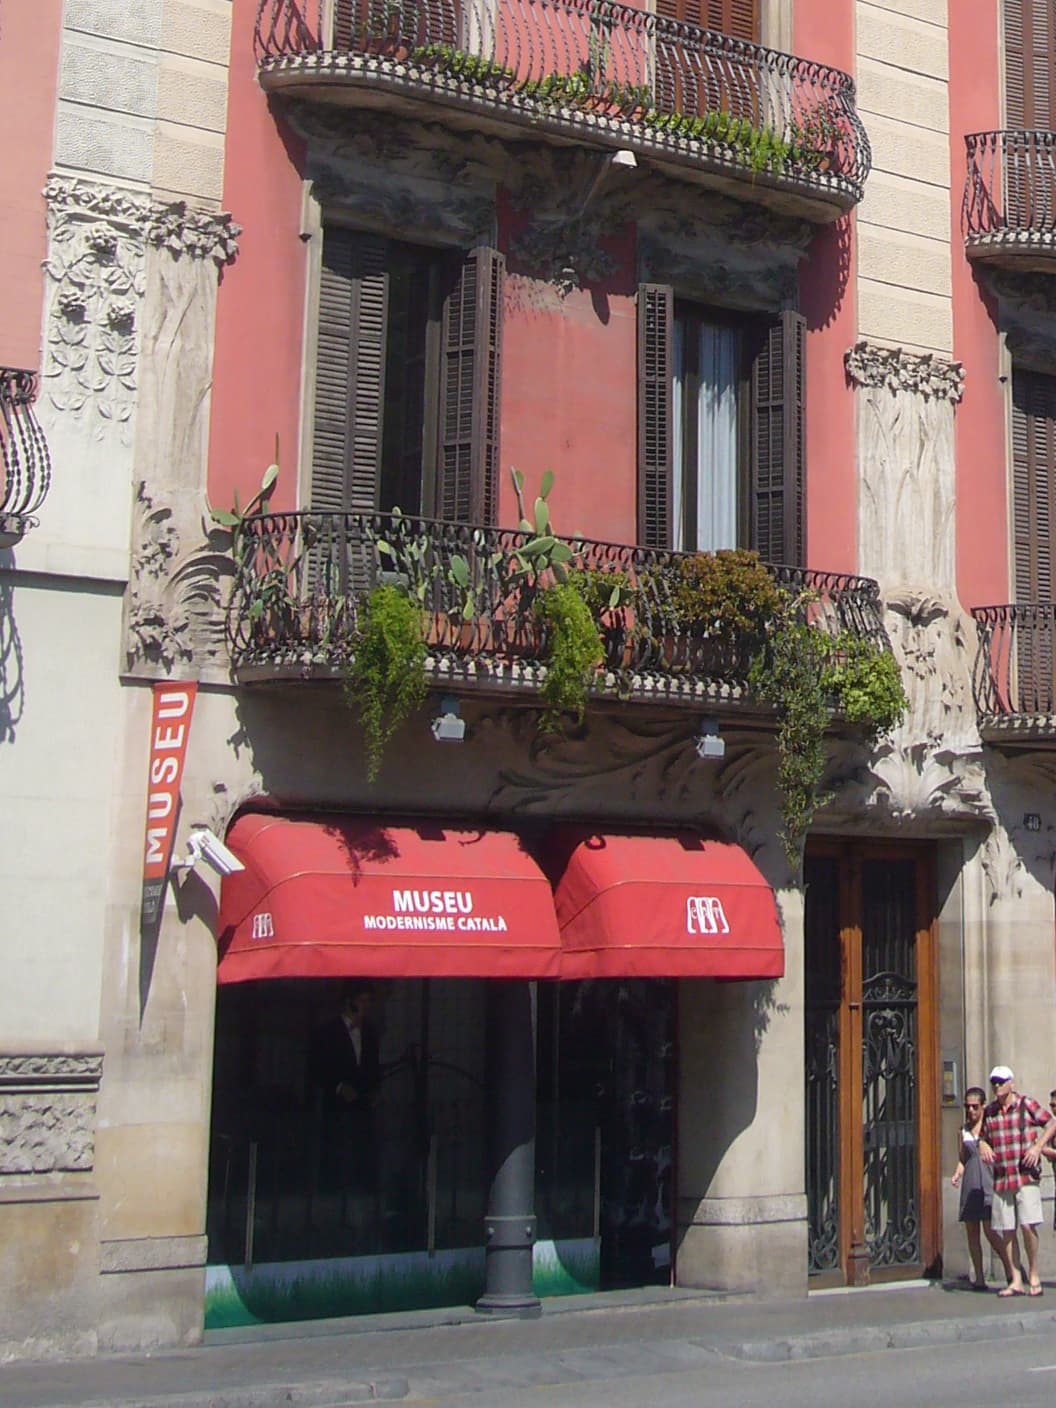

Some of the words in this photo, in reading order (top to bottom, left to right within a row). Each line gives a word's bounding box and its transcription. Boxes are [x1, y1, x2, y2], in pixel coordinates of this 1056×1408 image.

[145, 691, 189, 864] MUSEU
[392, 889, 474, 914] MUSEU
[363, 915, 455, 931] MODERNISME
[457, 914, 508, 932] CATALÀ
